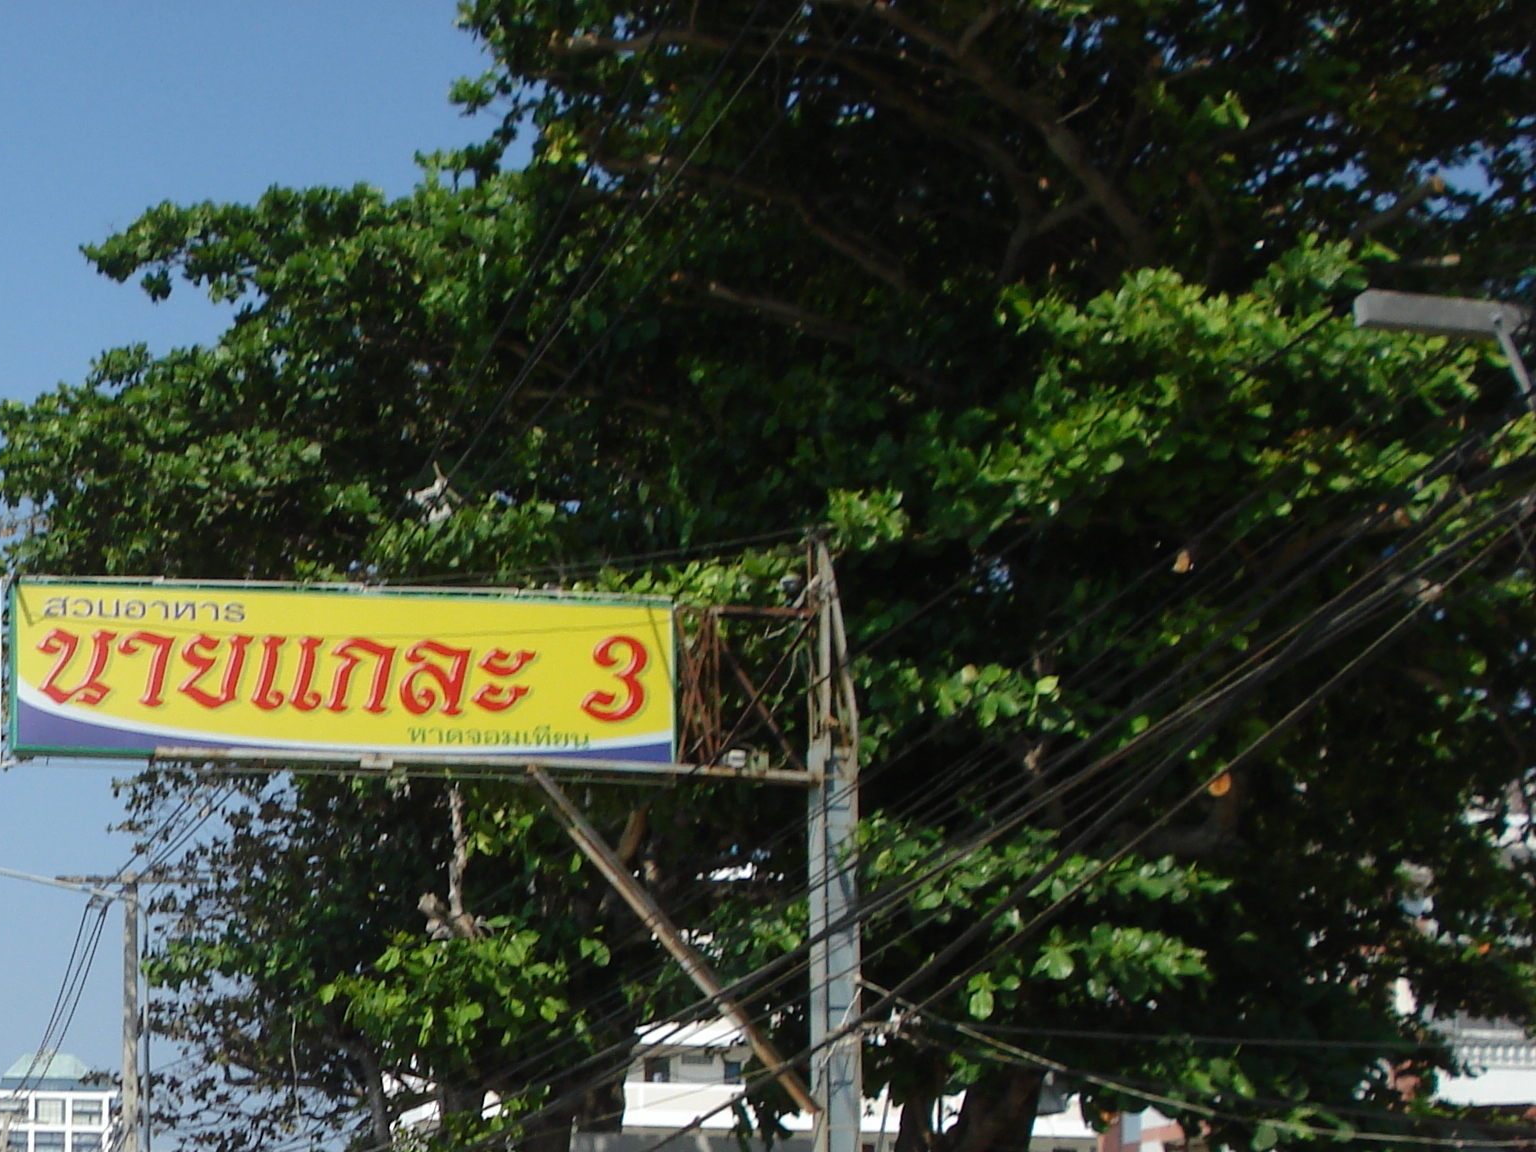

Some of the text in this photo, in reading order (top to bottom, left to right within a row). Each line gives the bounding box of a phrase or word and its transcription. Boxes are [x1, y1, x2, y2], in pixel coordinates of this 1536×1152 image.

[43, 595, 247, 623] สวนอาหาร
[37, 627, 648, 723] นายแกละ 3
[407, 724, 590, 750] หาดจอมเทียน
